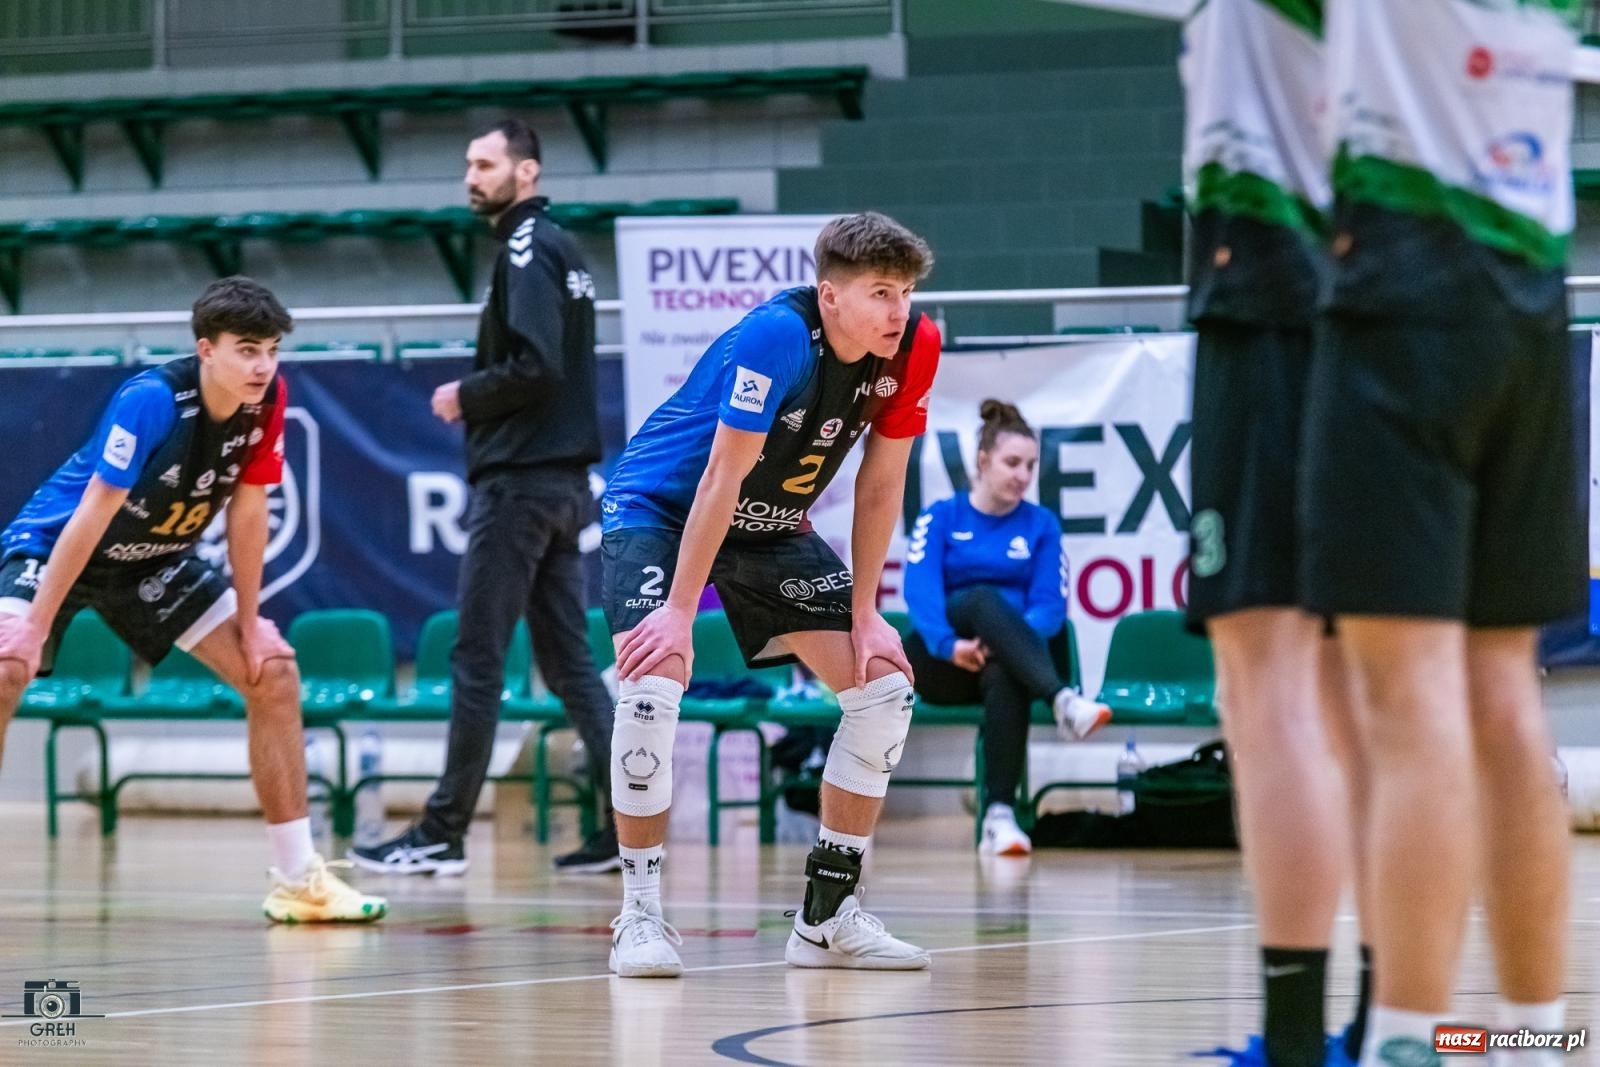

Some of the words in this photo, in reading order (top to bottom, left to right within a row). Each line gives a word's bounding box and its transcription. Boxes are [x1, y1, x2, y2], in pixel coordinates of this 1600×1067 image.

[651, 289, 770, 311] TECHNOL
[782, 454, 825, 495] 2
[150, 501, 210, 536] 18
[735, 497, 804, 521] NOWA
[640, 565, 665, 596] 2
[811, 568, 853, 593] BES
[625, 598, 666, 607] CUTLIN
